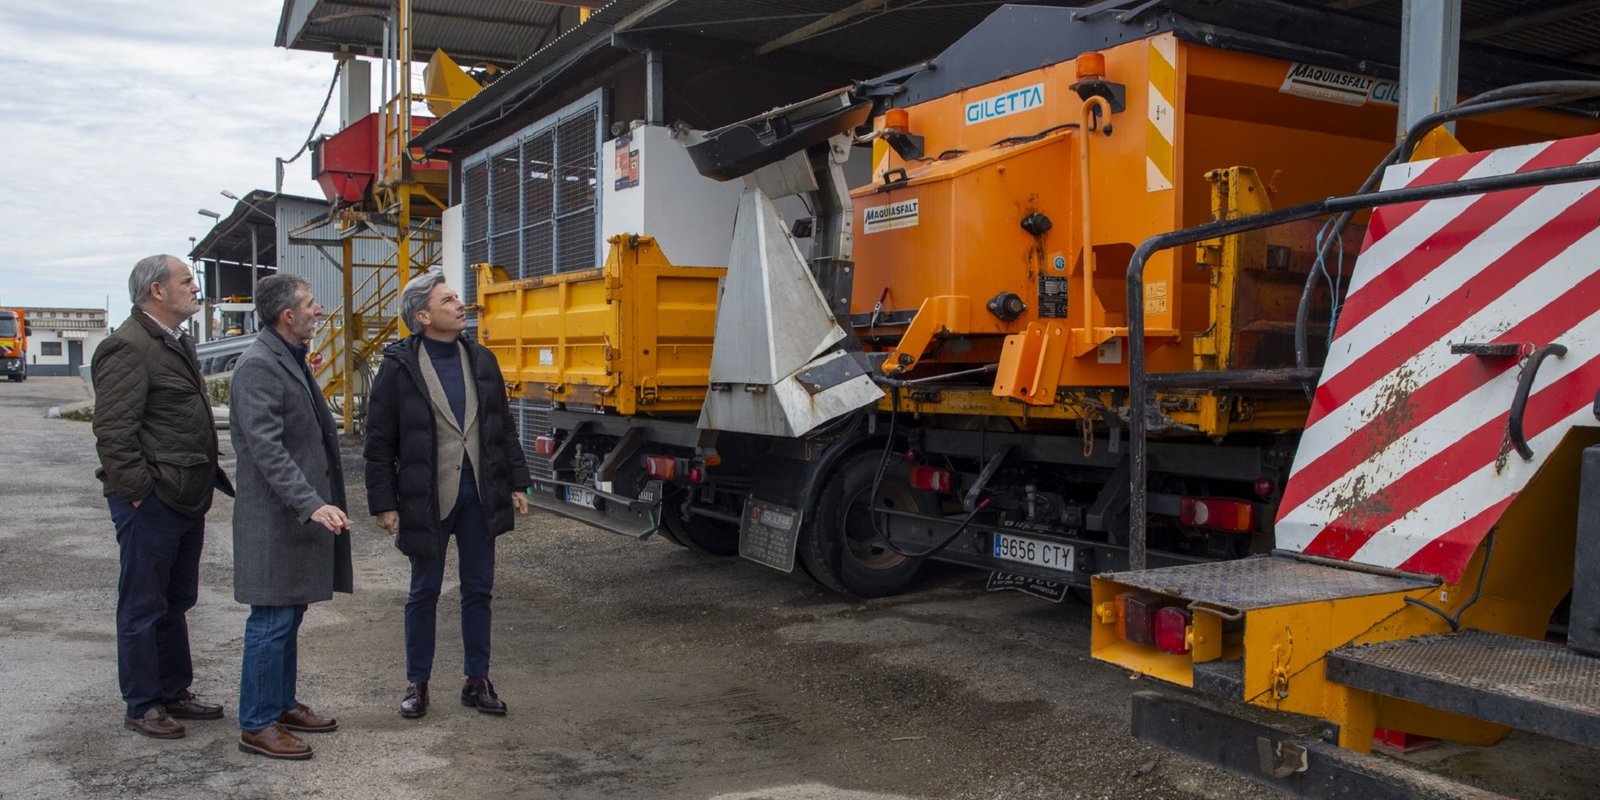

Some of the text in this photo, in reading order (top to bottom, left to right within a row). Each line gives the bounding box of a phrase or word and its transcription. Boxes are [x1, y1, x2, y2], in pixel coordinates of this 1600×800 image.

[1287, 64, 1373, 89] MAQUIASFALT
[967, 86, 1042, 122] GILETTA
[864, 202, 918, 224] MAQUIASFALT
[1002, 538, 1070, 567] 9656 CTY
